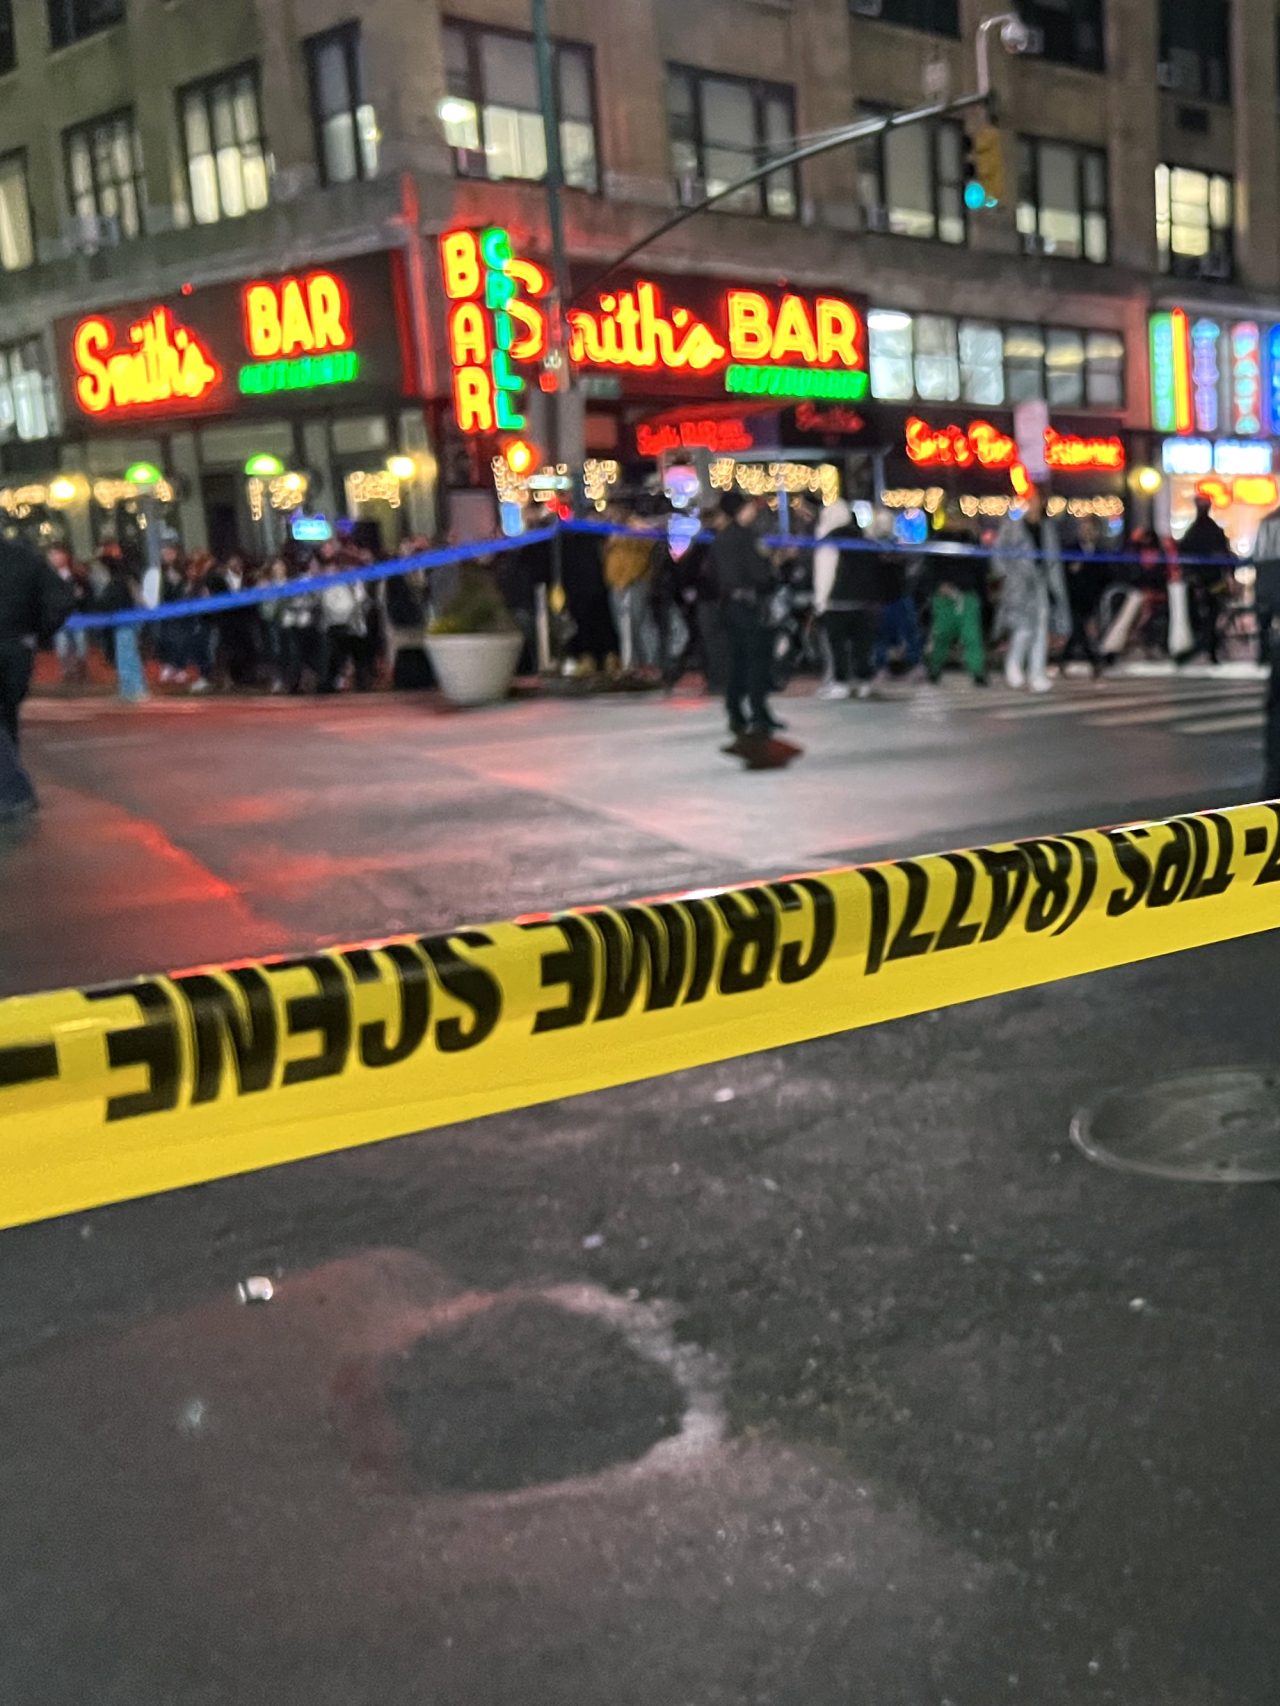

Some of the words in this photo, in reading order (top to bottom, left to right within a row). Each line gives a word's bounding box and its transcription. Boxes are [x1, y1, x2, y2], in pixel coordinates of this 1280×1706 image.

[74, 305, 221, 414] Smith's
[245, 272, 349, 358] BAR
[440, 229, 498, 432] BAR
[727, 290, 863, 369] BAR
[78, 927, 506, 1123] SCENE
[518, 878, 838, 1034] CRIME
